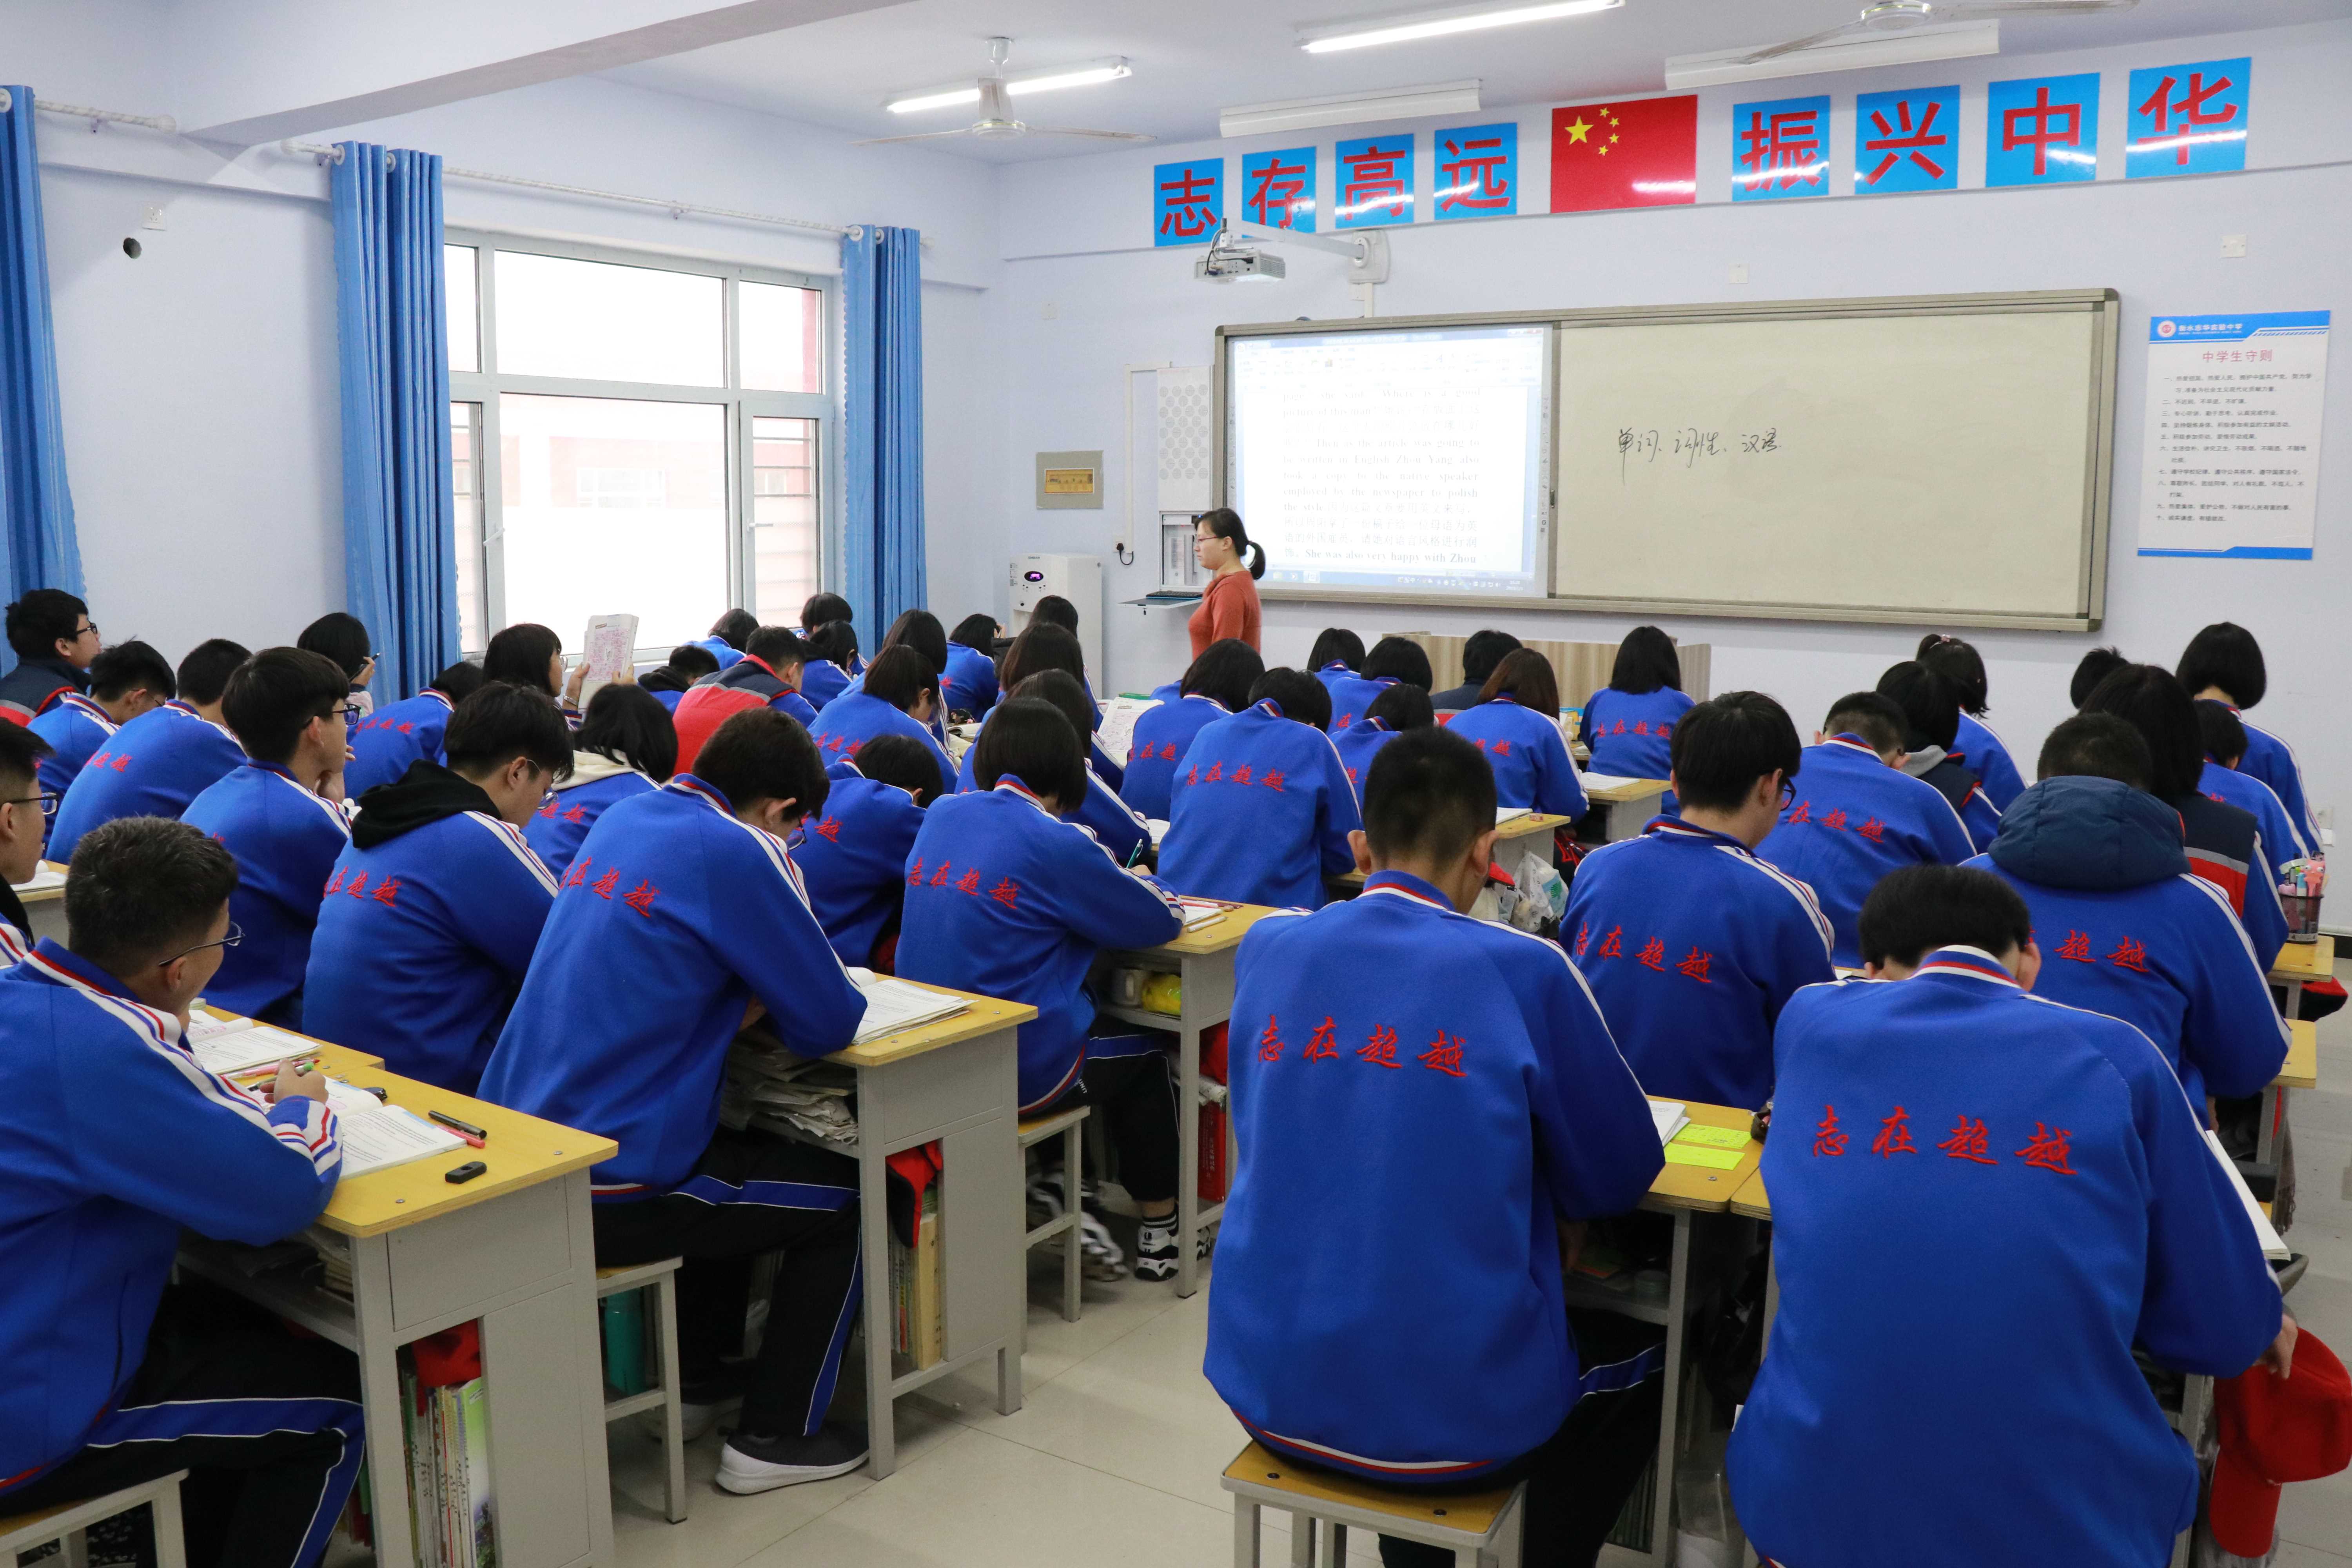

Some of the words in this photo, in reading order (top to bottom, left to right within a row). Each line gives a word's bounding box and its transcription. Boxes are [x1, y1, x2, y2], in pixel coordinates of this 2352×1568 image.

[1160, 138, 1510, 237] 志存高远
[1740, 73, 2238, 191] 振兴中华
[2202, 349, 2273, 363] 中学生守则
[1372, 489, 1425, 499] newspaper
[1448, 488, 1477, 500] polish
[1439, 470, 1479, 483] speaker
[1305, 548, 1321, 558] She
[1345, 549, 1364, 559] also
[1367, 552, 1387, 563] very
[1391, 552, 1419, 564] happy
[1424, 552, 1446, 563] with
[1450, 552, 1477, 564] Zhou
[1128, 740, 1182, 762] 志在超
[1187, 761, 1285, 792] 志在超越
[907, 857, 1021, 910] 志在超越
[1576, 921, 1713, 984] 志在超越
[2038, 928, 2149, 973] 超越
[1258, 1014, 1468, 1078] 志在超越
[1813, 1104, 2078, 1175] 志在超越
